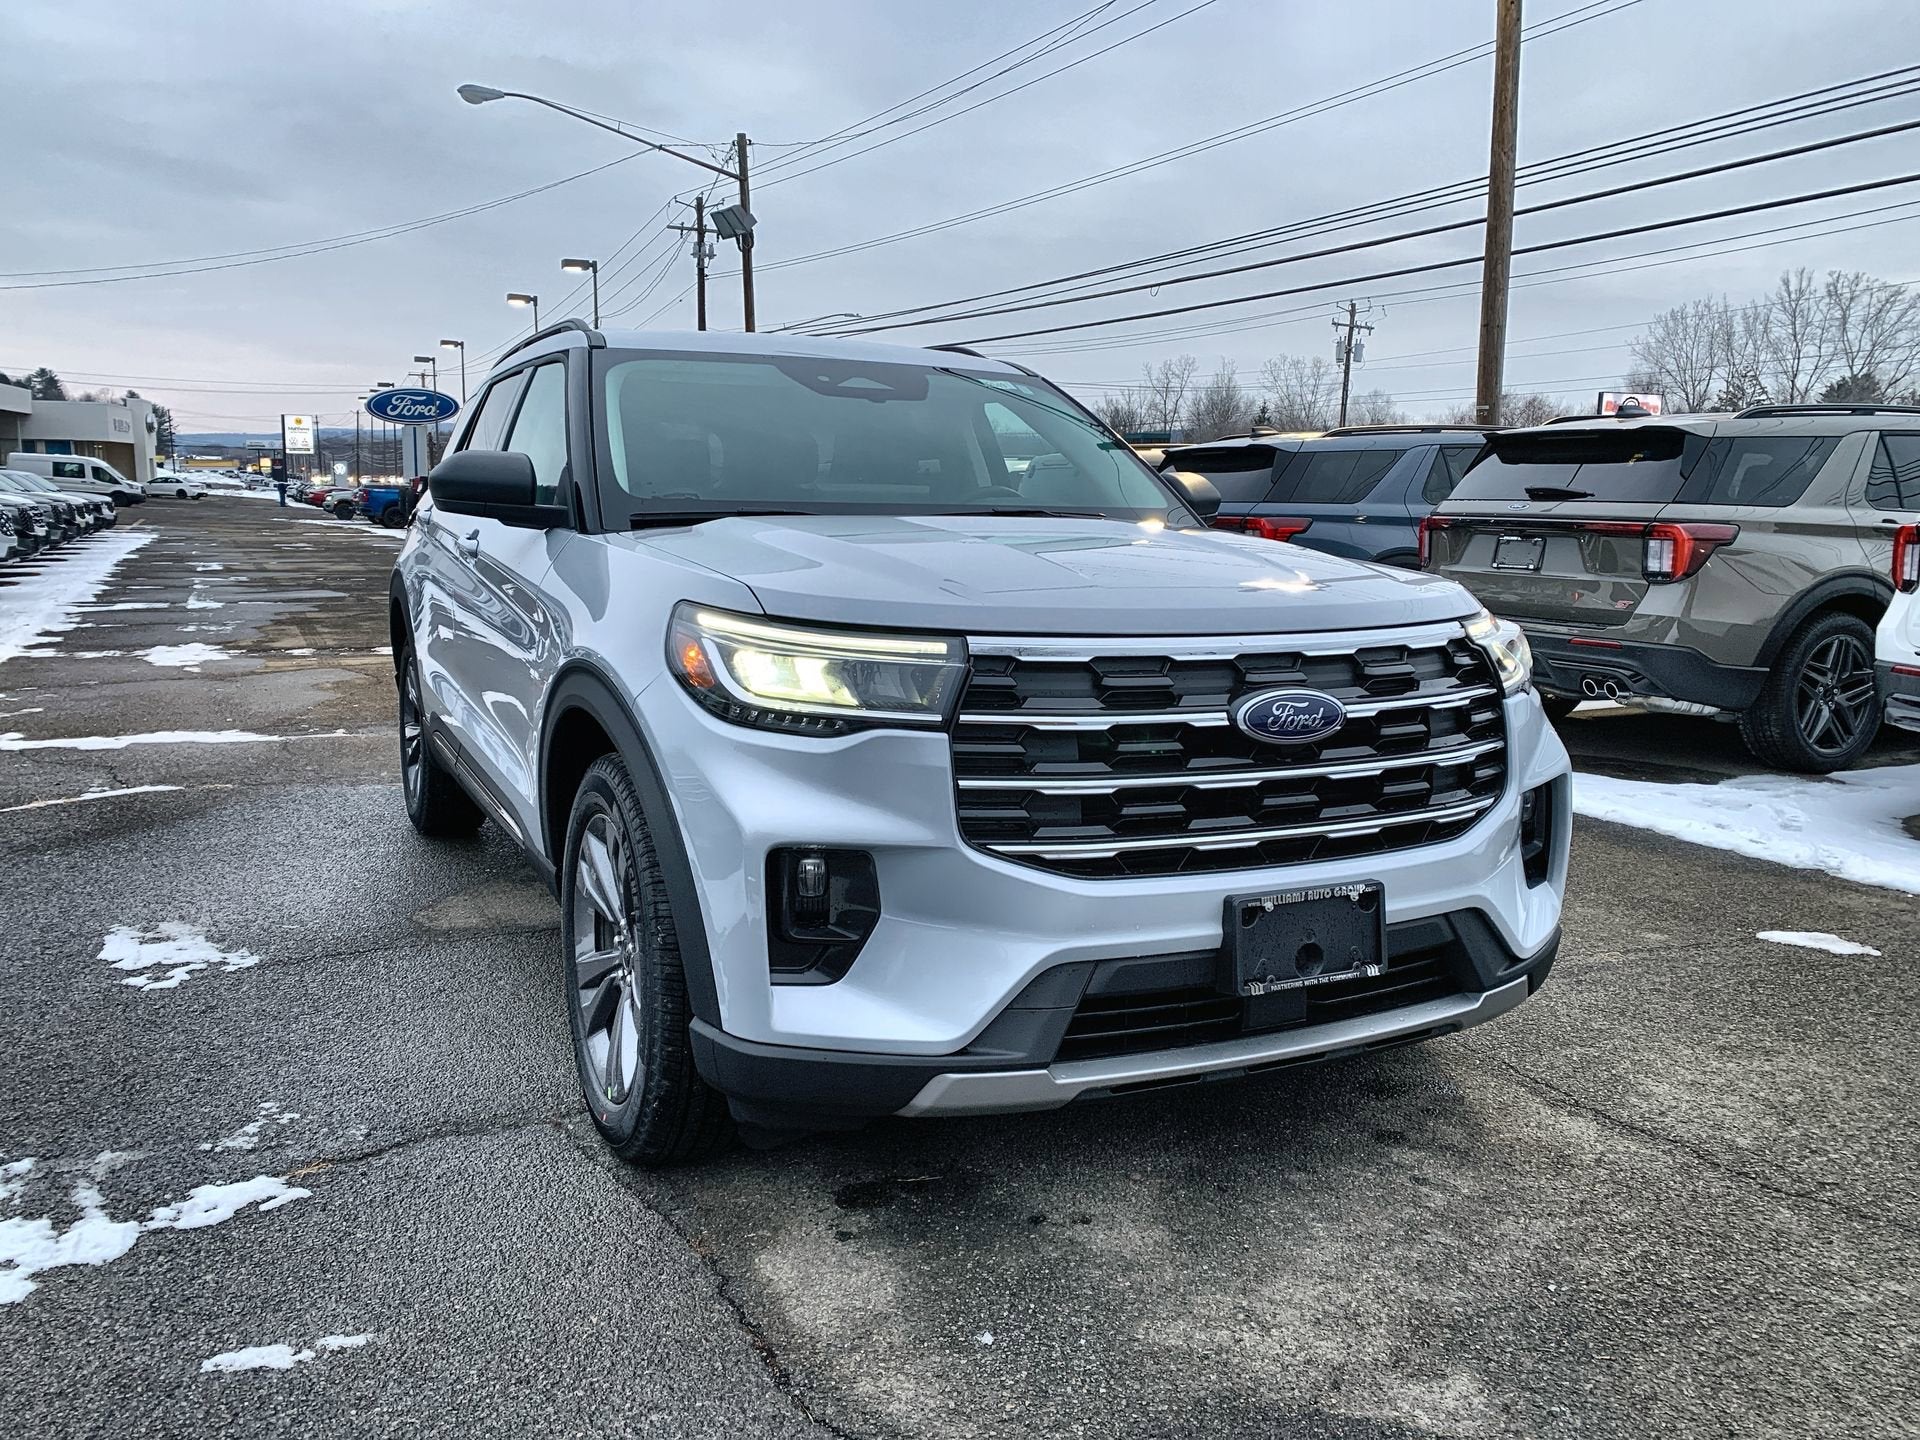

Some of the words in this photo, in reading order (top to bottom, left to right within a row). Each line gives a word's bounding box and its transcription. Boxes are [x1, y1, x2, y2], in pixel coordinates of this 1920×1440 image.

[386, 394, 440, 416] Ford
[1267, 701, 1324, 731] Ford
[1307, 888, 1332, 901] AUTO
[1270, 981, 1303, 991] PARTNERING
[1304, 978, 1319, 986] WITH
[1319, 976, 1329, 984] THE
[1329, 972, 1361, 982] COMMUNITY
